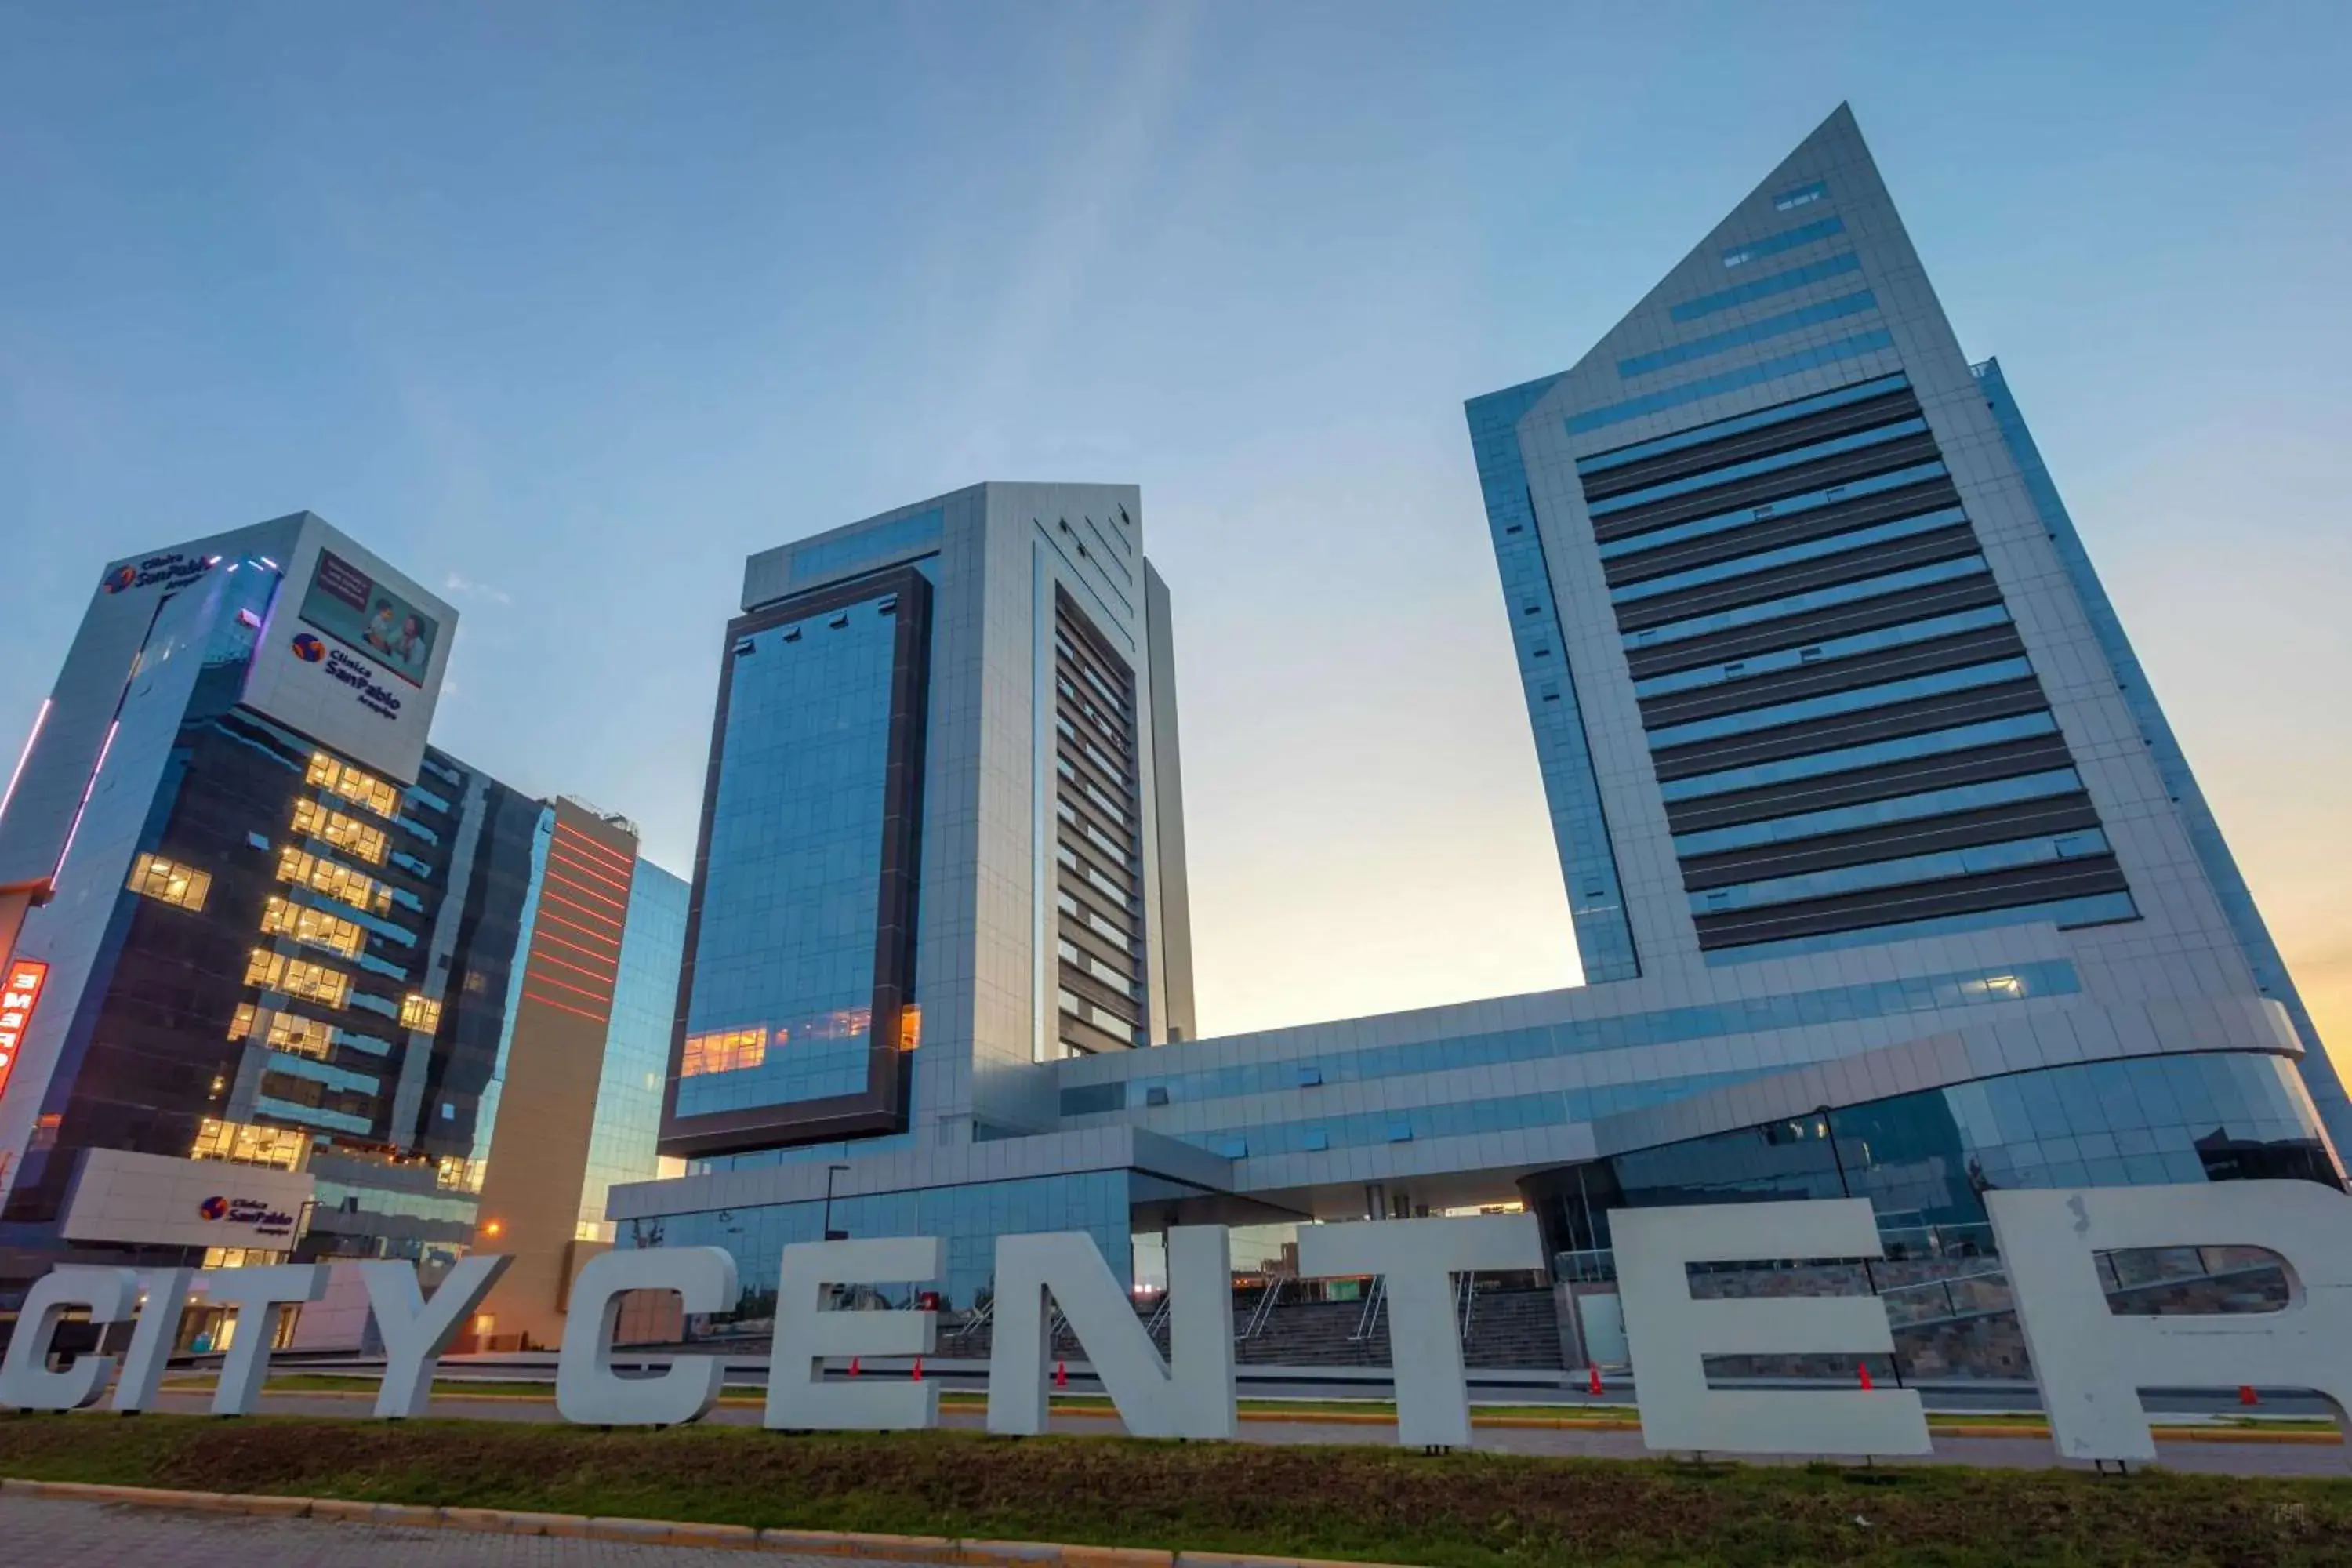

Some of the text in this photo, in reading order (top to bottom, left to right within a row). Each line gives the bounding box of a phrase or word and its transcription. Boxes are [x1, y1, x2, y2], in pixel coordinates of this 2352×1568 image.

[325, 659, 401, 710] SanPablo
[0, 1178, 2352, 1465] CITY CENTER
